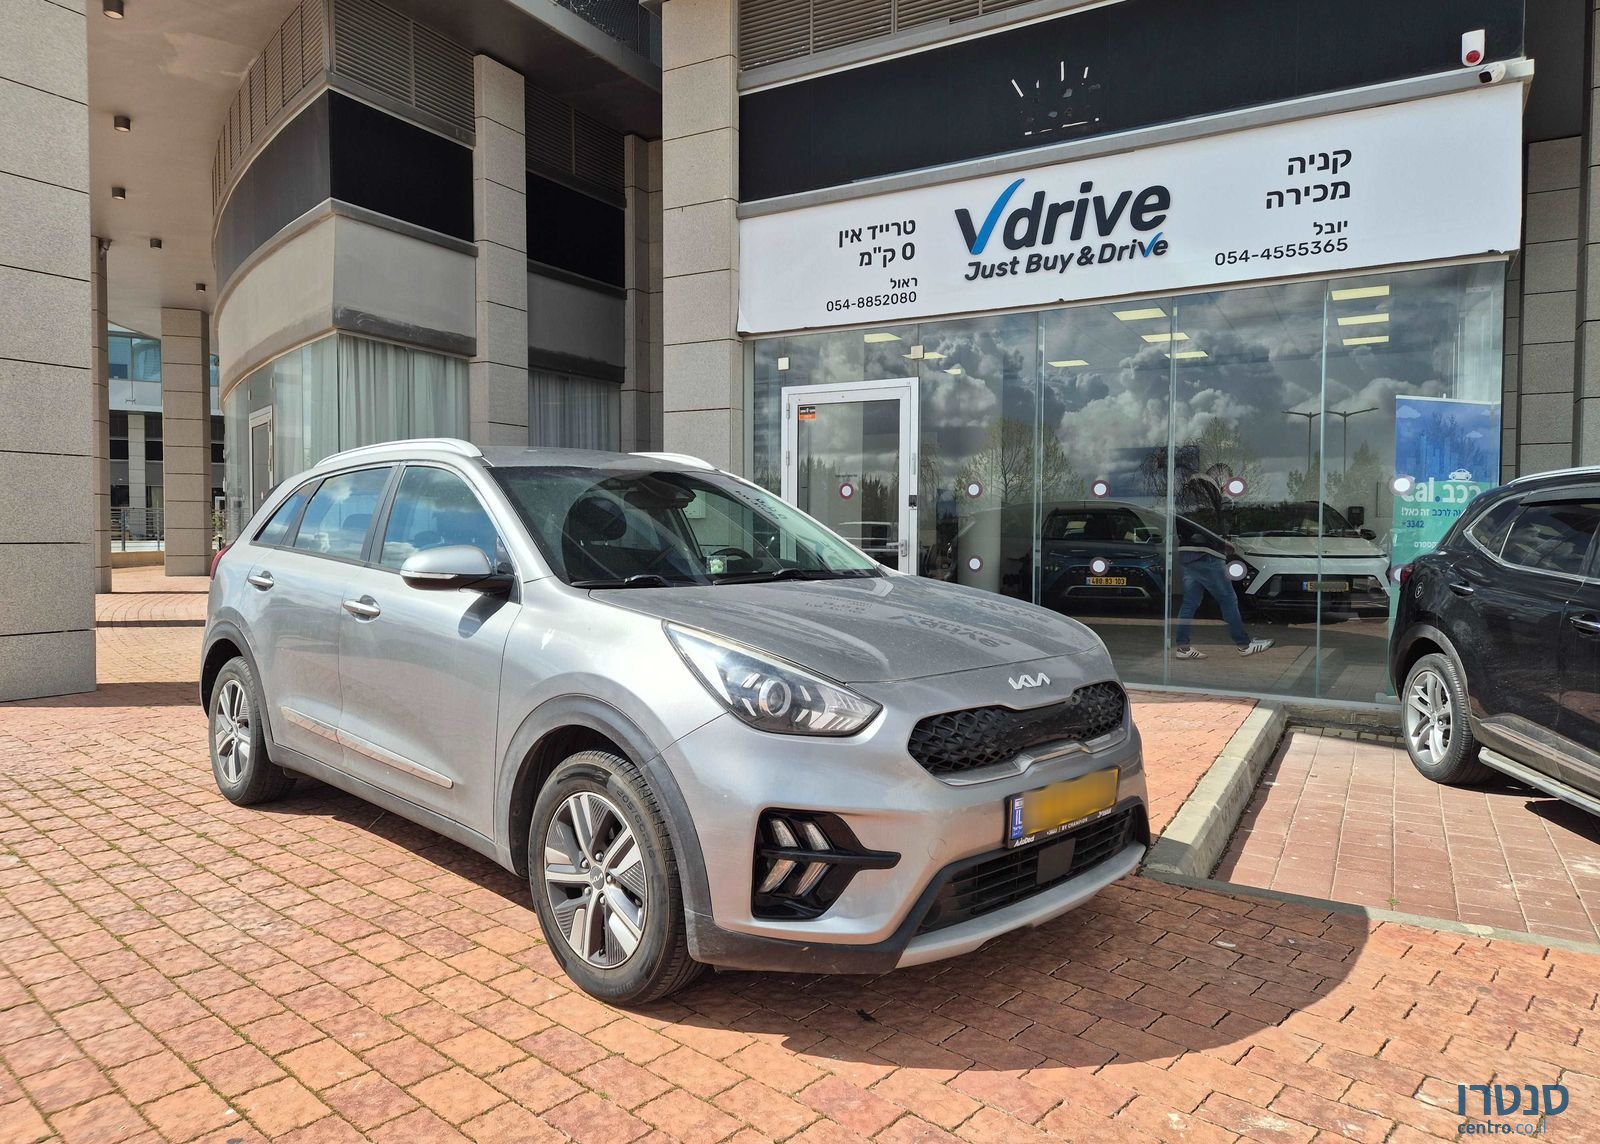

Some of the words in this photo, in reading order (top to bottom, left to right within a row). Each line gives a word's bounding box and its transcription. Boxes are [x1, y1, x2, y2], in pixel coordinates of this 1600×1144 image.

[1287, 148, 1352, 176] קניה
[1265, 180, 1351, 210] מכירה
[954, 177, 1171, 256] Vdrive
[1312, 220, 1348, 236] יובל
[838, 227, 862, 248] אין
[866, 219, 916, 240] טרייד
[964, 256, 1020, 281] Just
[1025, 252, 1074, 274] Buy
[1076, 245, 1095, 267] &
[1097, 232, 1169, 264] Drive
[1214, 237, 1349, 267] 054-4555365
[889, 277, 918, 290] ראול
[826, 291, 917, 312] 054-8852080
